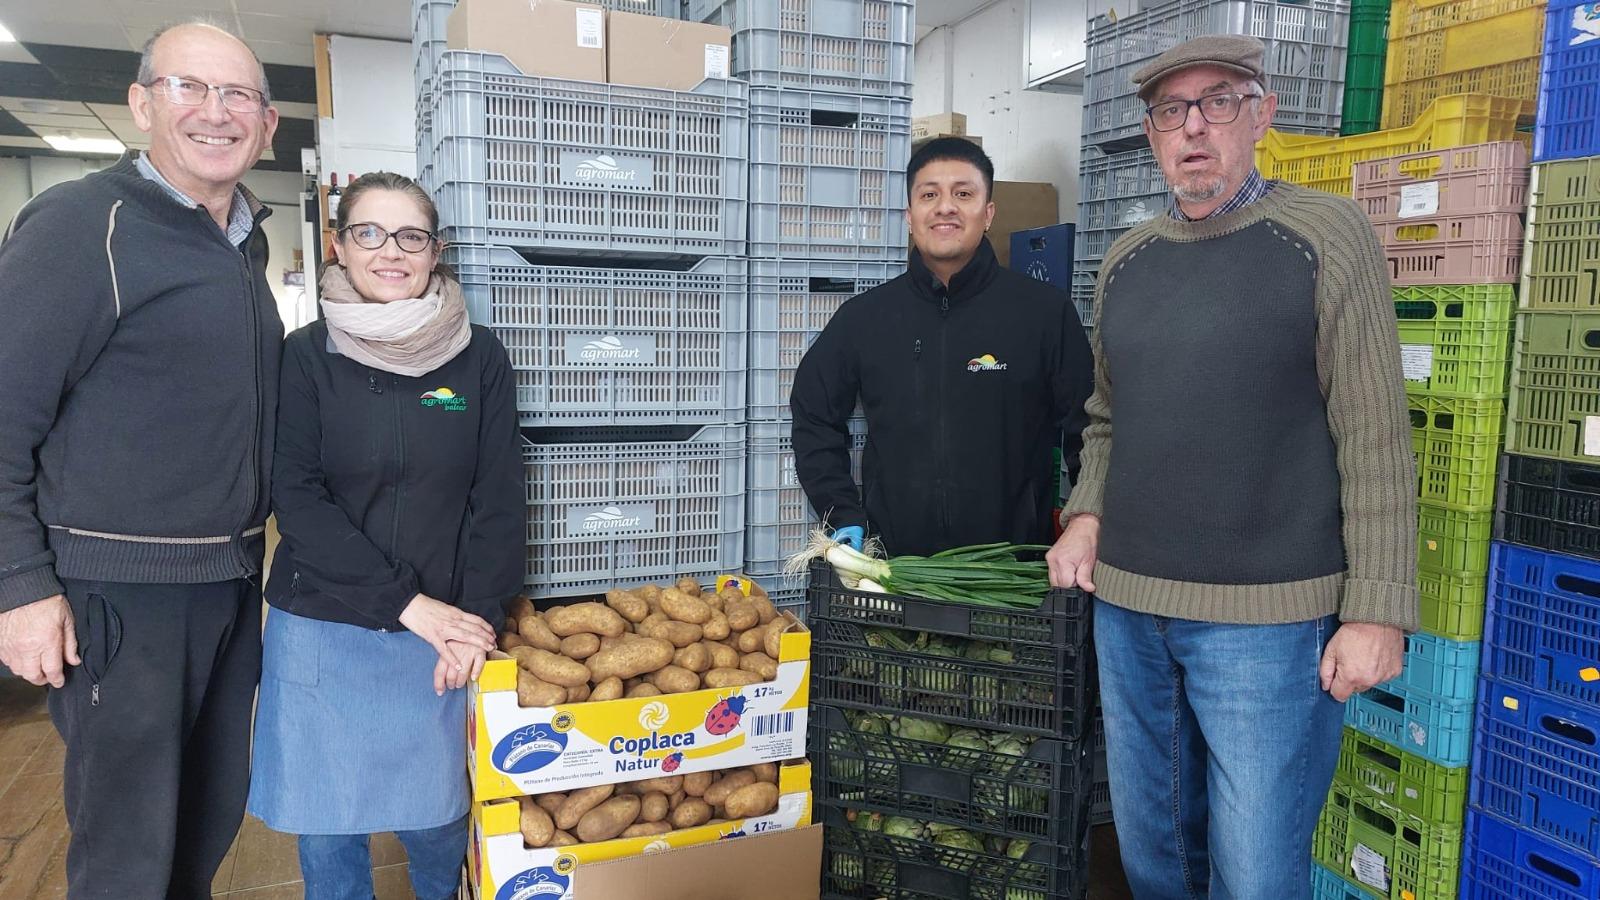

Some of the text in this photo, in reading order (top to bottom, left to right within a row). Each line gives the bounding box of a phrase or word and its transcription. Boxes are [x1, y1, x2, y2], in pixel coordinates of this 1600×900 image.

[575, 168, 636, 181] agromart
[580, 347, 640, 361] agromart
[967, 362, 1008, 372] agromart
[421, 396, 466, 407] agromart
[582, 515, 641, 531] agromart
[754, 687, 768, 698] 17
[609, 731, 695, 756] Coplaca
[615, 758, 660, 773] Natur
[754, 821, 768, 833] 17
